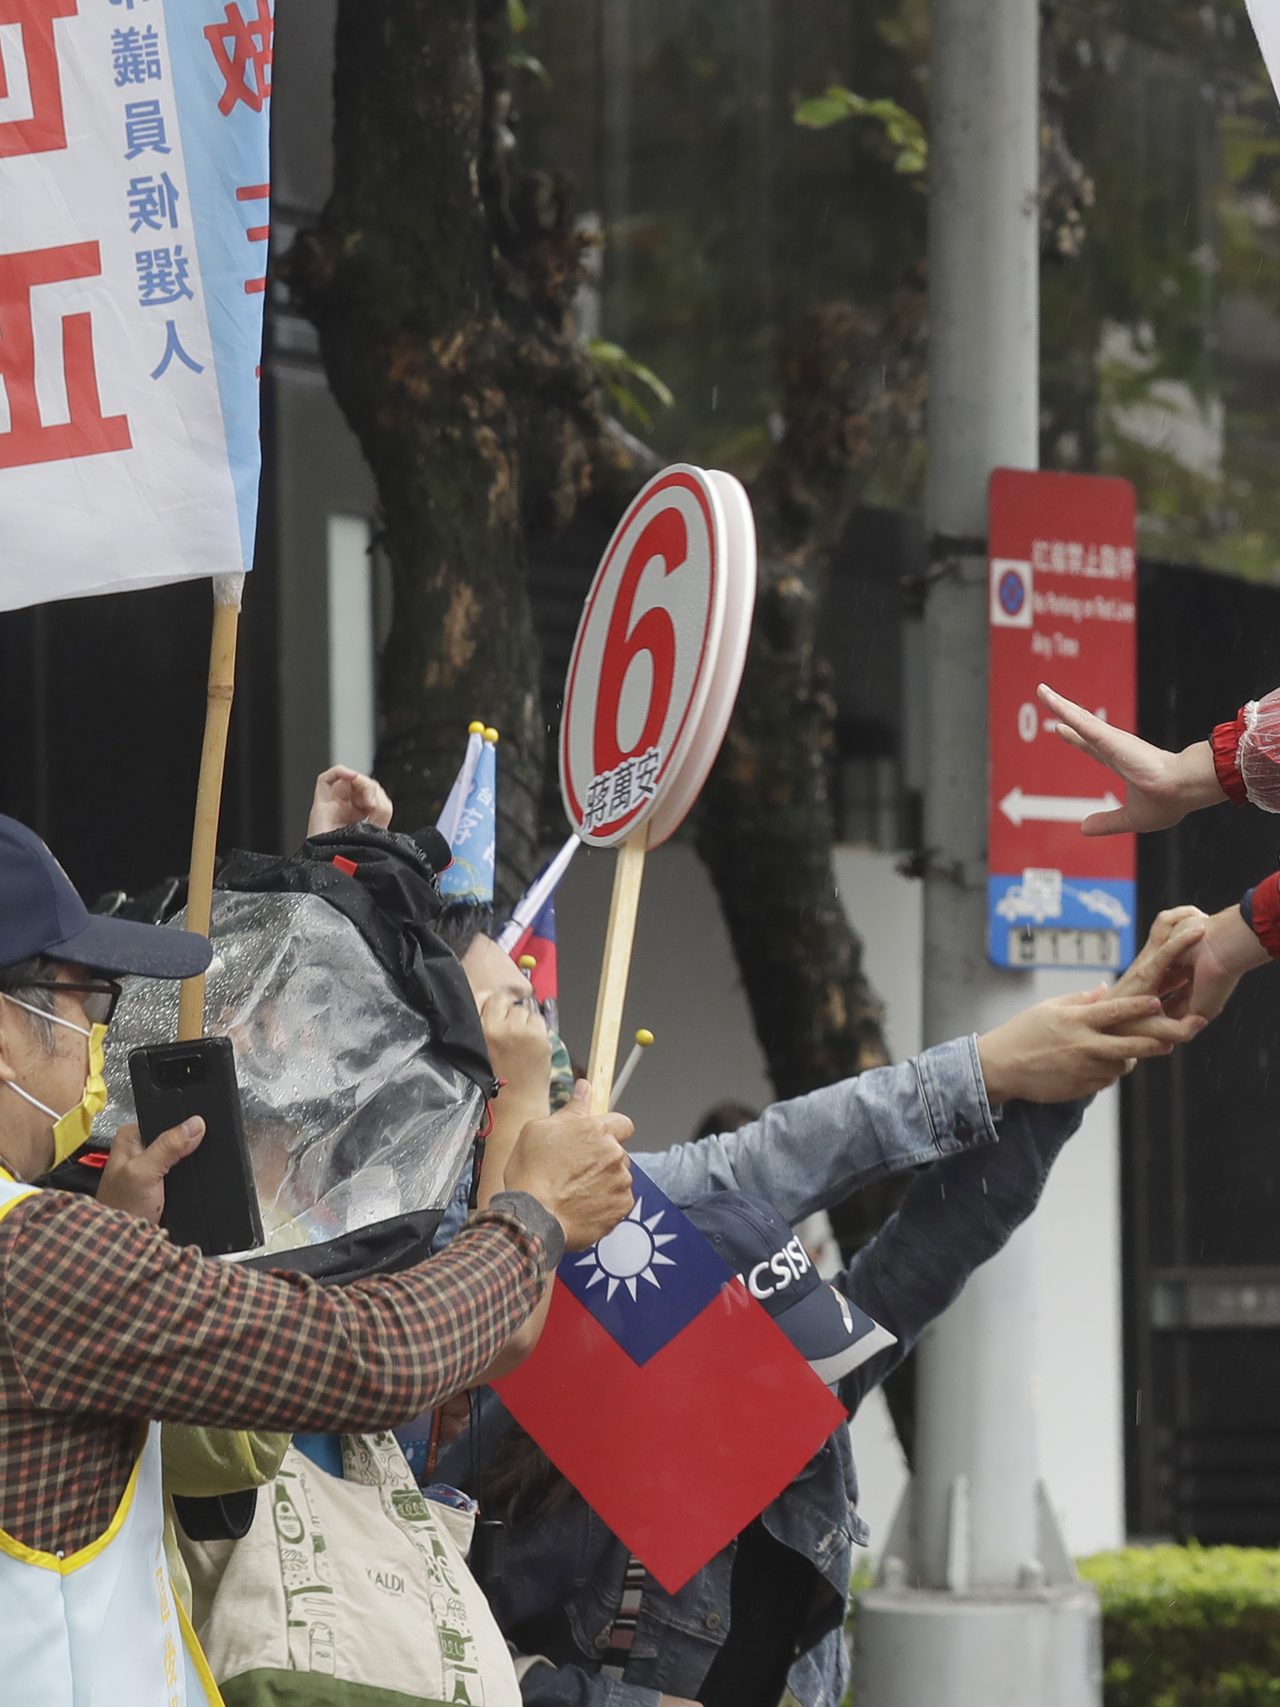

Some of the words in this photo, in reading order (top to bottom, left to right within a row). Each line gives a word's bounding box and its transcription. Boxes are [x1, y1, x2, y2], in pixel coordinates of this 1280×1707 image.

[592, 506, 688, 780] 6
[583, 751, 660, 830] 蔣萬安
